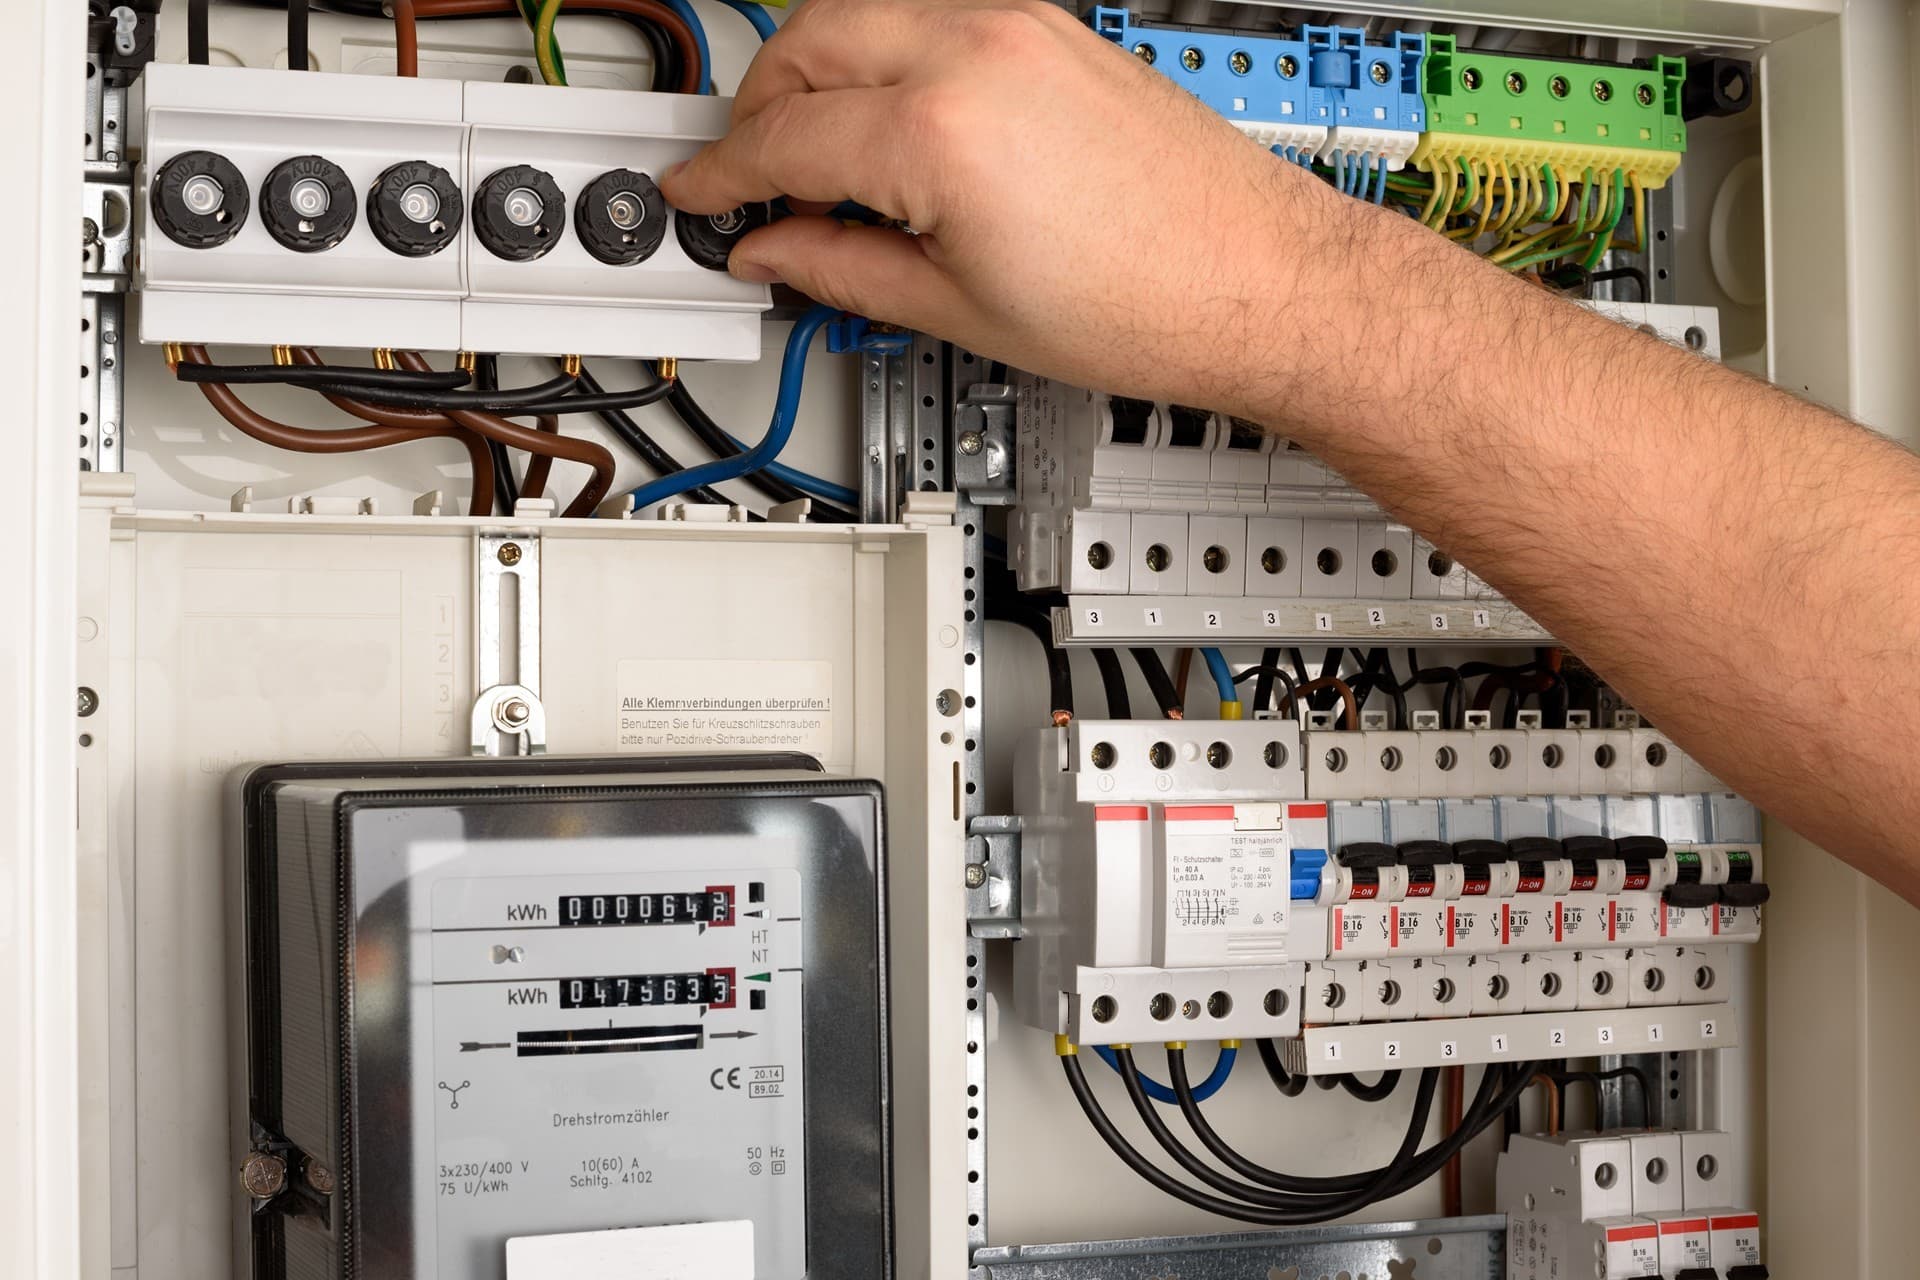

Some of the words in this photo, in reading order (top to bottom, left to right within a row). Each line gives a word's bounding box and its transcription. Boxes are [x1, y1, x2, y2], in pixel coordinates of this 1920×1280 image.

[1090, 611, 1099, 624] 3
[1149, 611, 1156, 623] 1
[1208, 614, 1217, 626] 2
[1267, 612, 1276, 624] 3
[1320, 616, 1327, 628] 1
[1372, 610, 1381, 622] 2
[1435, 616, 1444, 628] 3
[1477, 613, 1483, 625] 1
[438, 644, 449, 663] 2
[622, 697, 644, 709] Alle
[765, 697, 824, 710] überprüfen
[621, 718, 670, 729] Benutzen
[672, 718, 689, 729] Sie
[692, 718, 705, 729] für
[621, 734, 644, 745] bitte
[646, 735, 664, 745] nur
[1185, 865, 1193, 873] 40
[507, 903, 548, 921] kWh
[1563, 913, 1569, 923] B
[1572, 912, 1582, 922] 16
[1616, 912, 1622, 922] B
[1625, 912, 1634, 922] 16
[1676, 907, 1686, 917] 16
[1728, 907, 1737, 917] 16
[1343, 920, 1349, 930] B
[1352, 920, 1363, 931] 16
[1399, 917, 1405, 928] B
[1408, 917, 1419, 928] 16
[1455, 918, 1461, 928] B
[1463, 917, 1474, 928] 16
[1510, 916, 1516, 926] B
[1518, 915, 1529, 926] 16
[751, 929, 769, 944] HT
[751, 949, 769, 963] NT
[508, 987, 548, 1006] kWh
[1652, 1028, 1658, 1039] 1
[1705, 1023, 1713, 1034] 2
[1554, 1032, 1562, 1043] 2
[1601, 1030, 1609, 1041] 3
[1388, 1044, 1396, 1056] 2
[1445, 1044, 1453, 1056] 3
[1496, 1038, 1502, 1050] 1
[1329, 1045, 1336, 1057] 1
[754, 1069, 780, 1080] 20.14
[754, 1084, 780, 1095] 89.02
[552, 1109, 670, 1128] Drehstromzähler
[746, 1146, 762, 1159] 50
[770, 1146, 785, 1158] Hz
[439, 1161, 513, 1179] 3x230/400
[521, 1160, 530, 1173] V
[581, 1156, 624, 1174] 10(60)
[631, 1157, 640, 1169] A
[621, 1171, 653, 1184] 4102
[440, 1182, 456, 1196] 75
[464, 1179, 509, 1197] U/kWh
